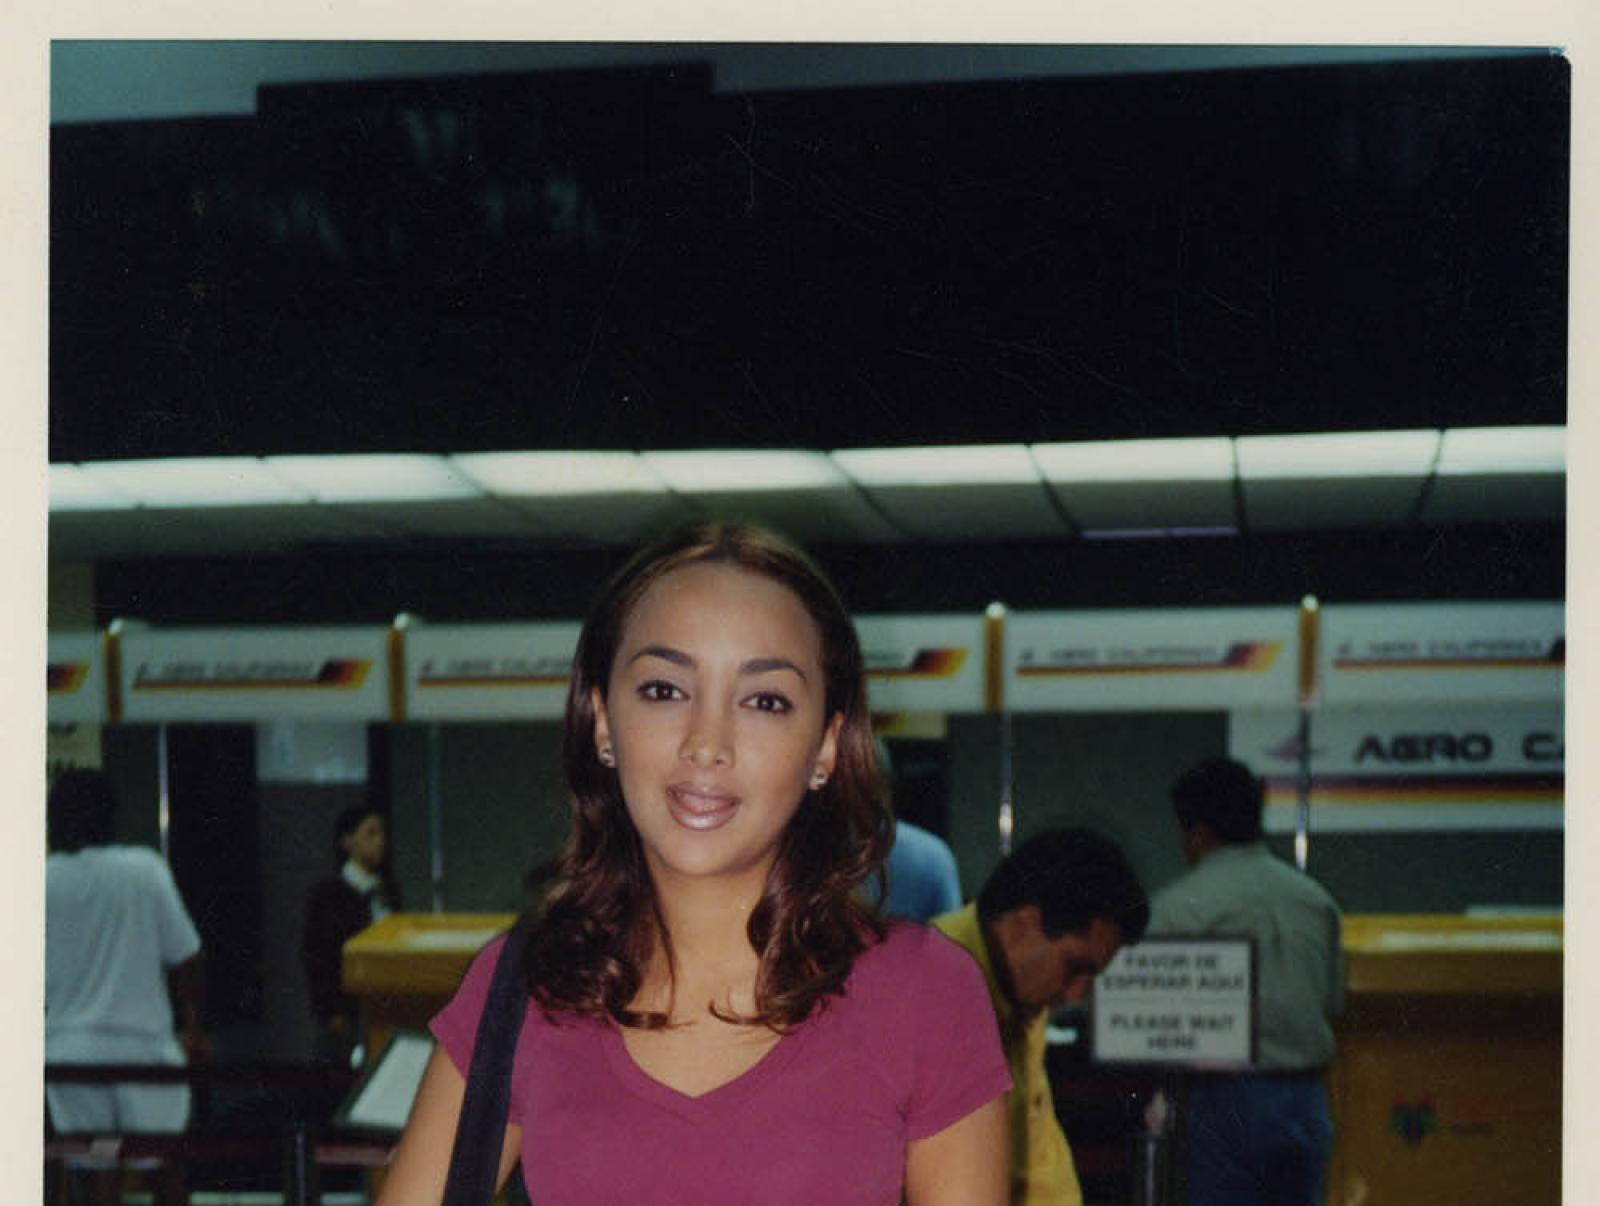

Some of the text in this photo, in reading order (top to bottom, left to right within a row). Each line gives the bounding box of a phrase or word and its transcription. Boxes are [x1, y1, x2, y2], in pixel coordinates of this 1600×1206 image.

[1355, 732, 1493, 764] AERO
[1124, 954, 1218, 969] FAVOR DE
[1103, 974, 1192, 990] ESPERAR
[1110, 1014, 1235, 1030] PLEASE WAIT
[1147, 1036, 1195, 1050] HERE
